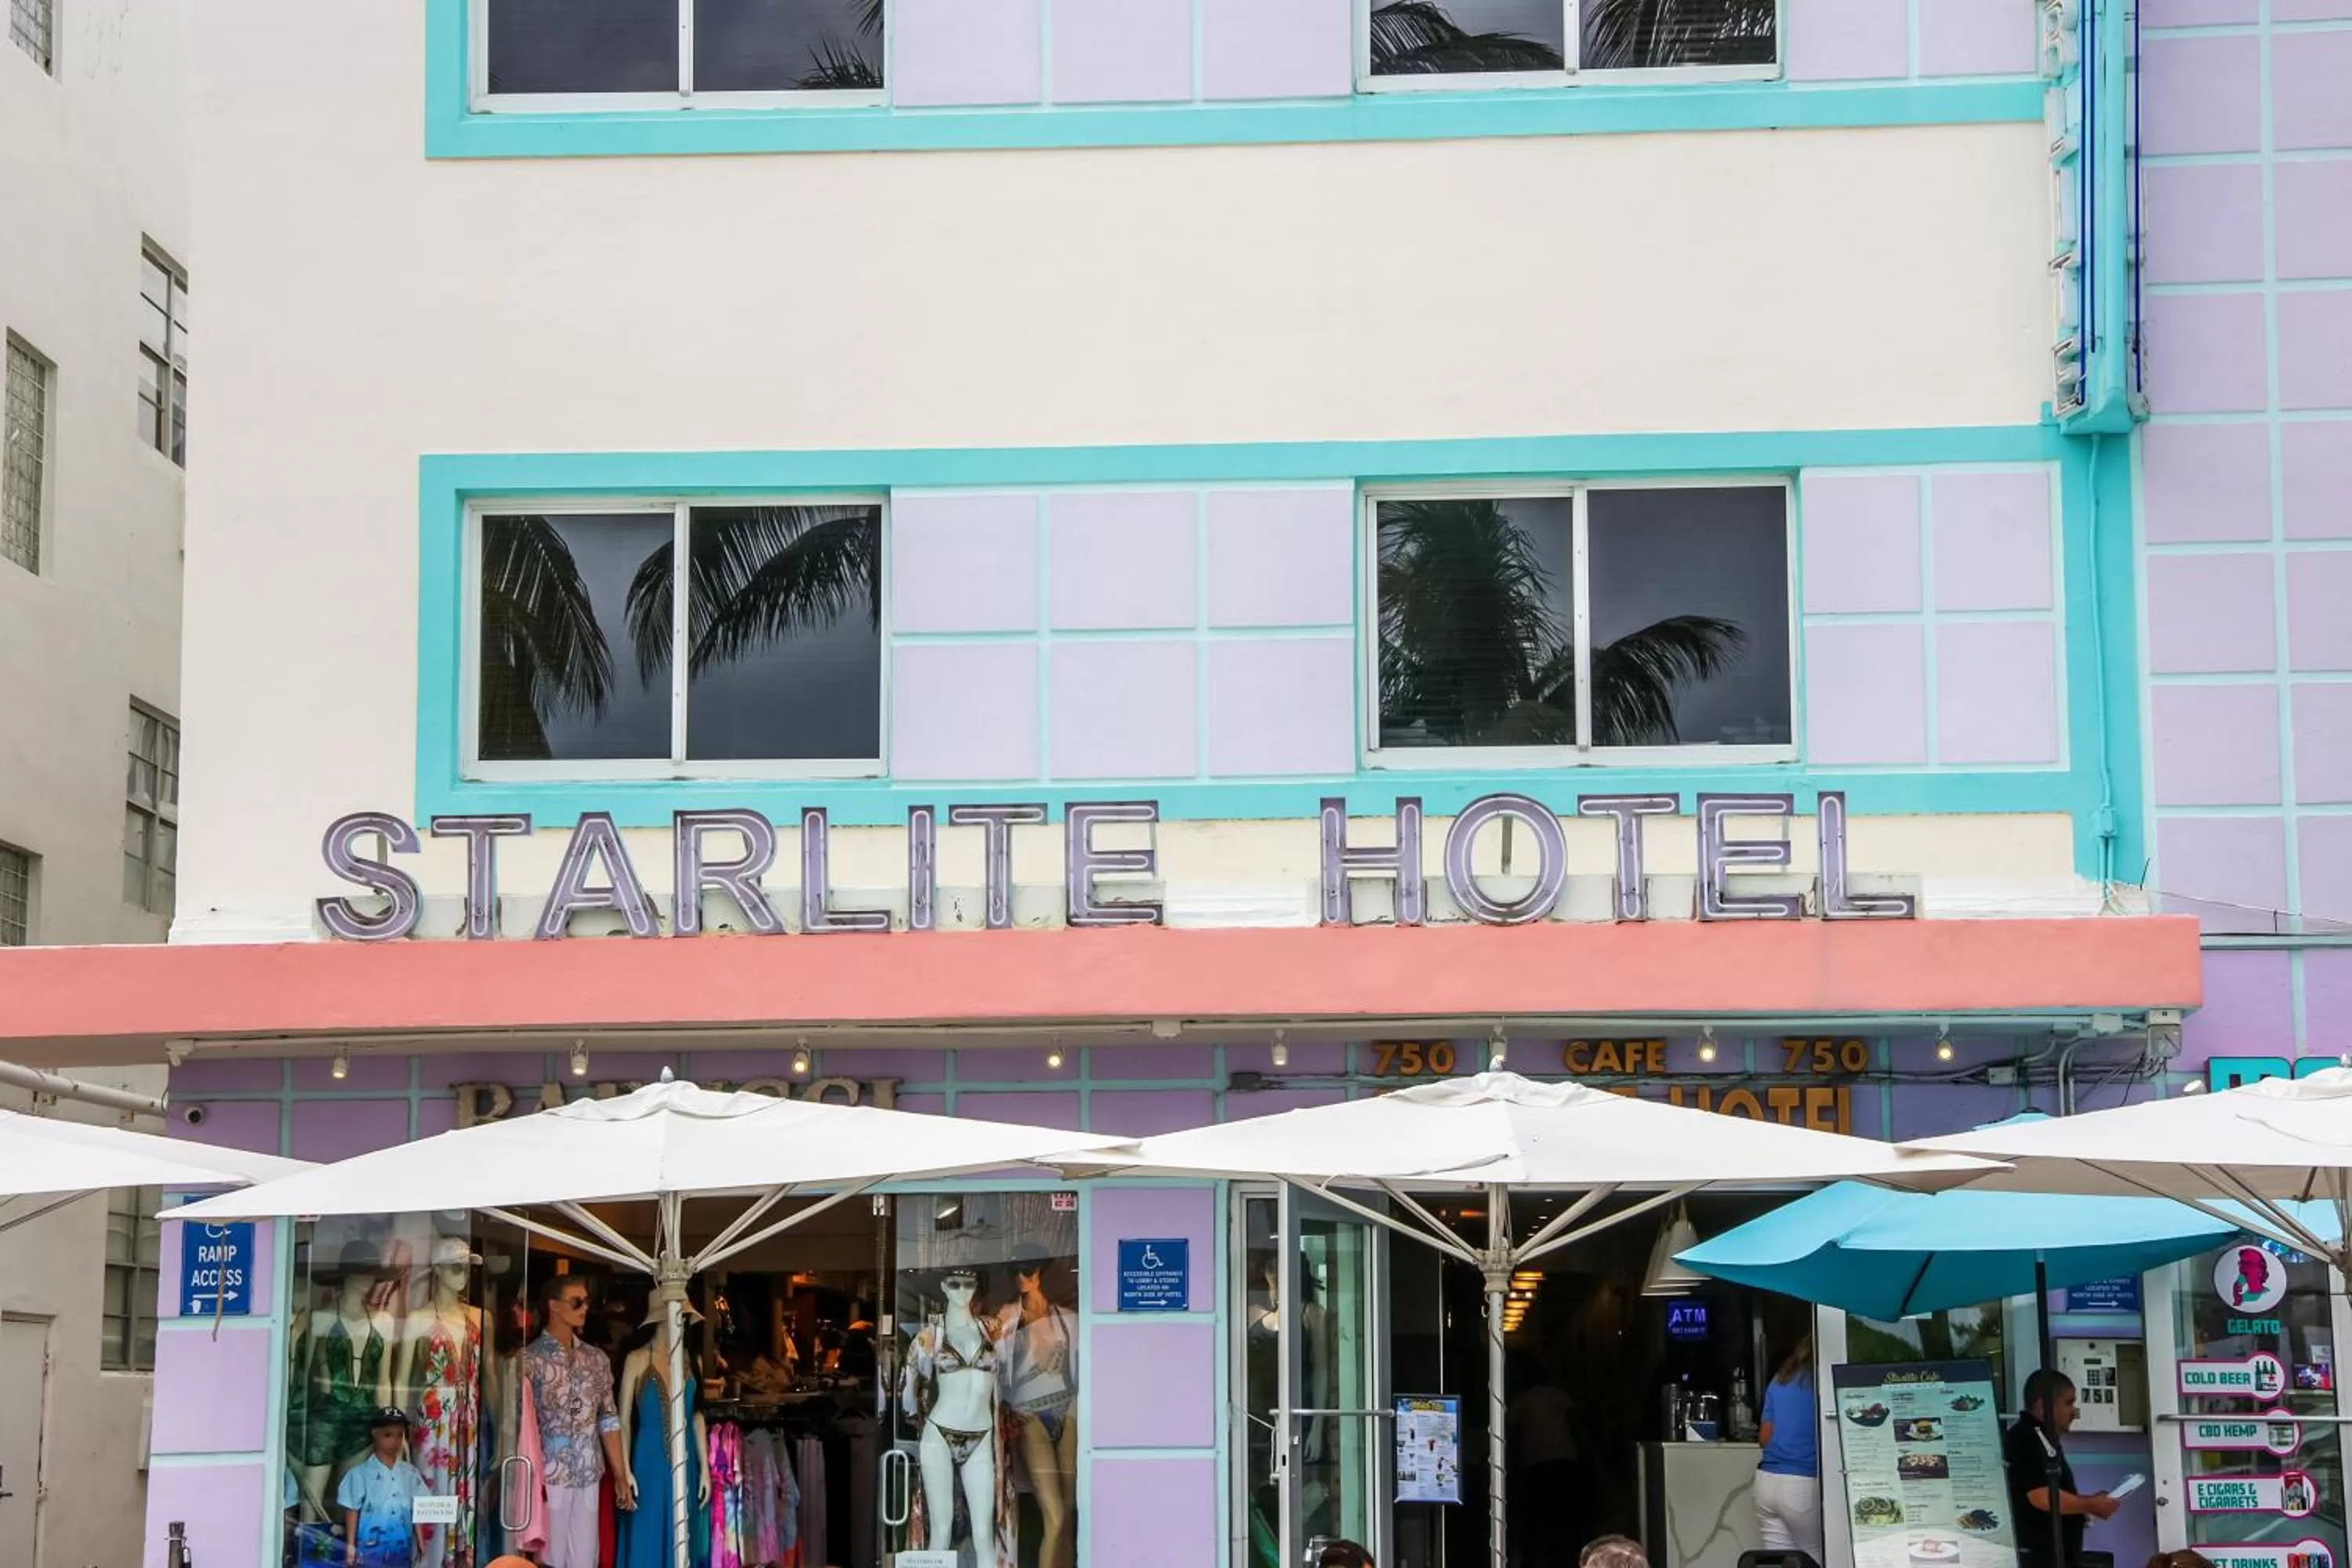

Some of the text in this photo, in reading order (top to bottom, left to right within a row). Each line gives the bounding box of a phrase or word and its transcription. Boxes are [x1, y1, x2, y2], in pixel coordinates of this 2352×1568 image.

[315, 791, 1915, 941] STARLITE HOTEL
[1372, 1040, 1456, 1076] 750
[1563, 1038, 1668, 1074] CAFE
[1781, 1038, 1869, 1073] 750
[198, 1245, 238, 1263] RAMP
[1671, 1308, 1706, 1323] ATM
[2227, 1319, 2281, 1334] GELATO
[2185, 1372, 2251, 1385] COLD BEER
[2082, 1388, 2114, 1404] 750
[2198, 1425, 2257, 1437] CBD HEMP
[2198, 1483, 2257, 1496] E CIGARS &
[2232, 1558, 2278, 1568] DRINKS
